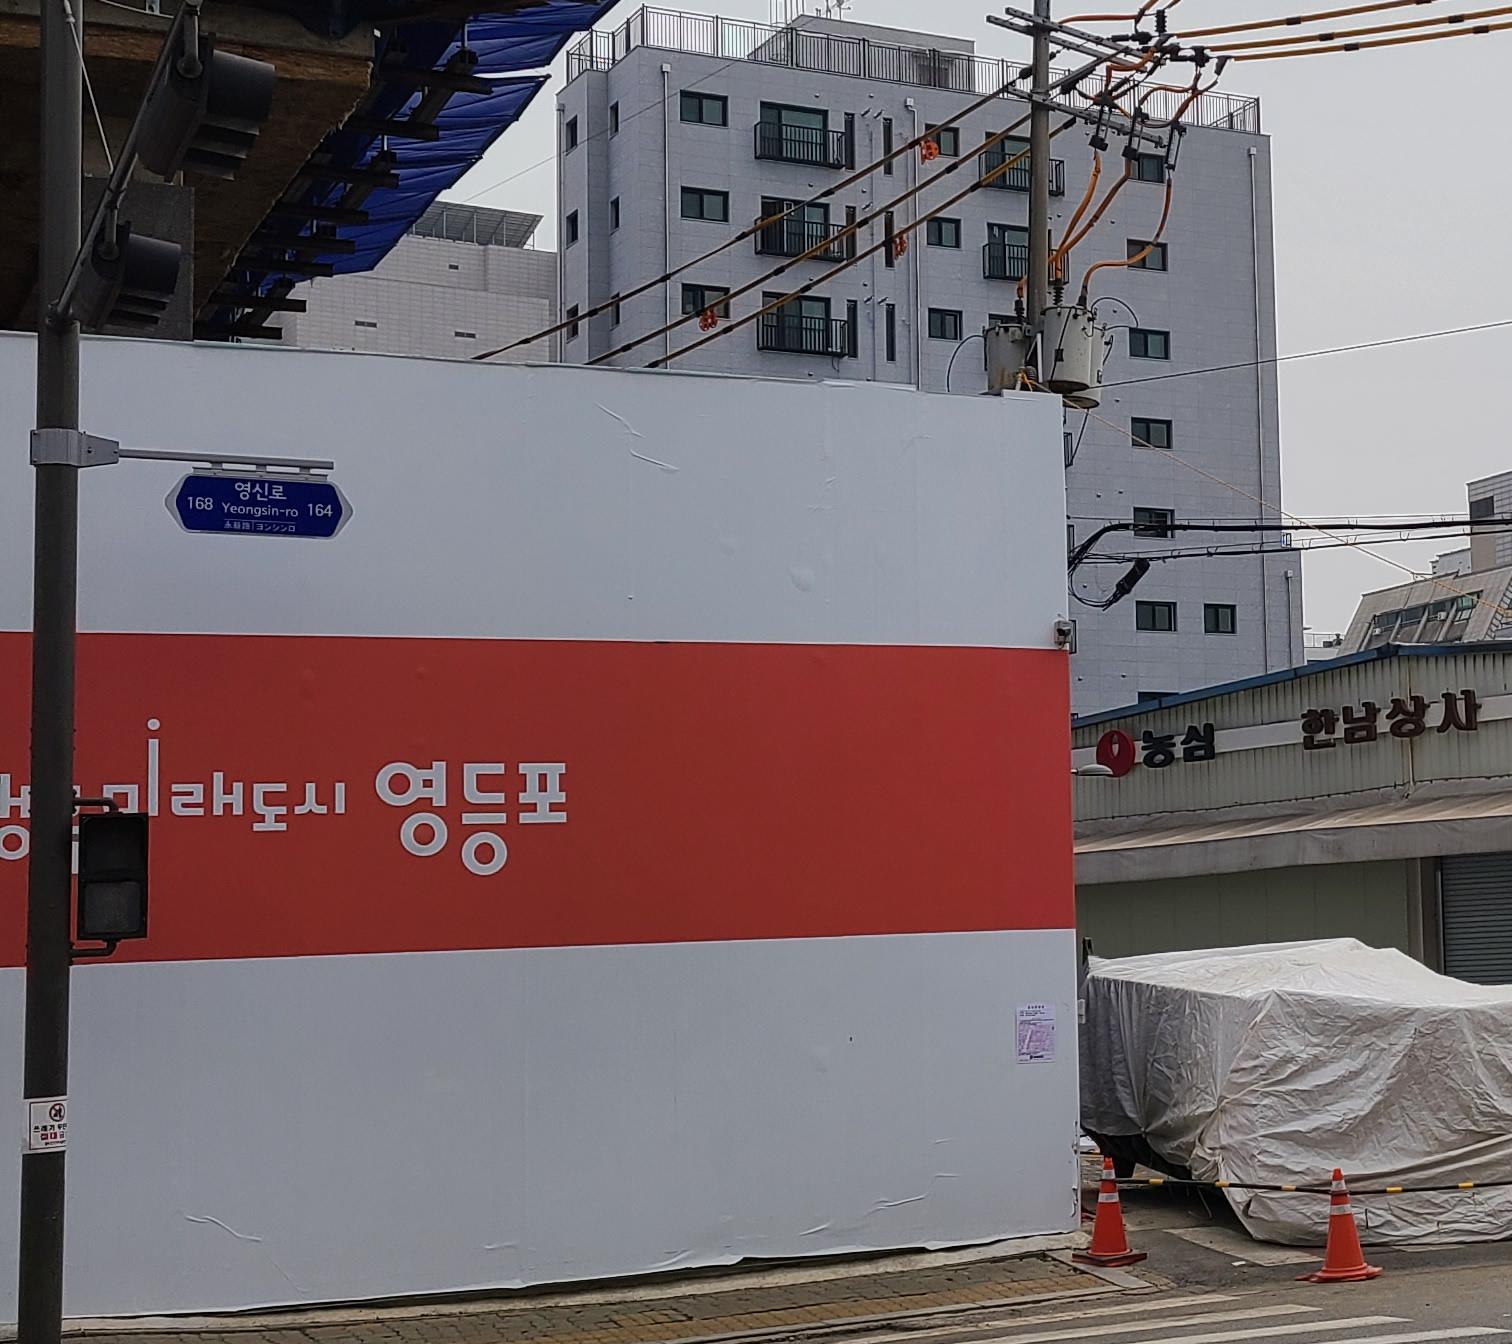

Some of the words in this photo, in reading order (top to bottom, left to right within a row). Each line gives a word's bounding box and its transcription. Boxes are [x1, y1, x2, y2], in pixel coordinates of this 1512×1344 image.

[234, 481, 287, 501] 영신로
[187, 496, 213, 511] 168
[222, 502, 299, 518] Yeongsin-ro
[307, 503, 333, 518] 164
[1301, 688, 1482, 751] 한남상사
[1141, 722, 1216, 768] 농심
[102, 718, 346, 832] 미래도시
[375, 760, 567, 876] 영등포
